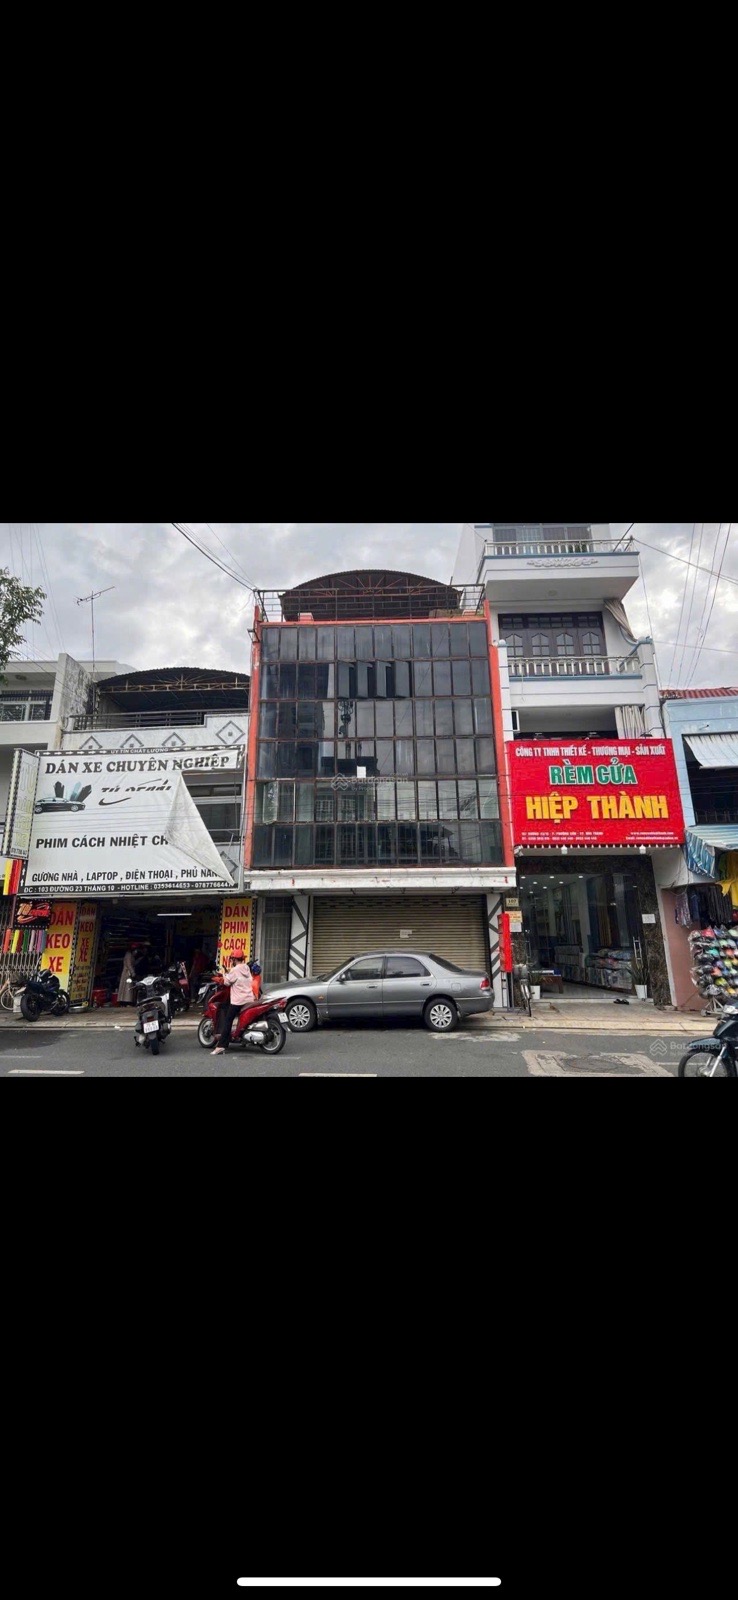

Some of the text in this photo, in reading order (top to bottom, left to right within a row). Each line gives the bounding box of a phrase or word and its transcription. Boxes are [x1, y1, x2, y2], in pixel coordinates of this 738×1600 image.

[516, 744, 666, 757] CÔNG TY TNHH THIẾT KẾ THƯƠNG MẠI SẢN XUẤT
[45, 754, 230, 774] DÁN XE CHUYÊN NGHIỆP
[549, 757, 638, 785] RÈM CỬA
[526, 790, 668, 824] HIỆP THÀNH
[36, 838, 68, 848] PHIM
[72, 834, 106, 848] CÁCH
[110, 834, 148, 848] NHIỆT
[32, 866, 221, 882] GƯƠNG NHÀ LAPTOP ĐIỆN THOẠI PHỦ NAN
[50, 884, 74, 892] ĐƯỜNG
[50, 904, 74, 926] DÁN
[226, 902, 248, 918] DÁN
[224, 922, 248, 934] PHIM
[46, 934, 70, 948] KEO
[224, 935, 246, 950] CÁCH
[49, 956, 64, 972] XE
